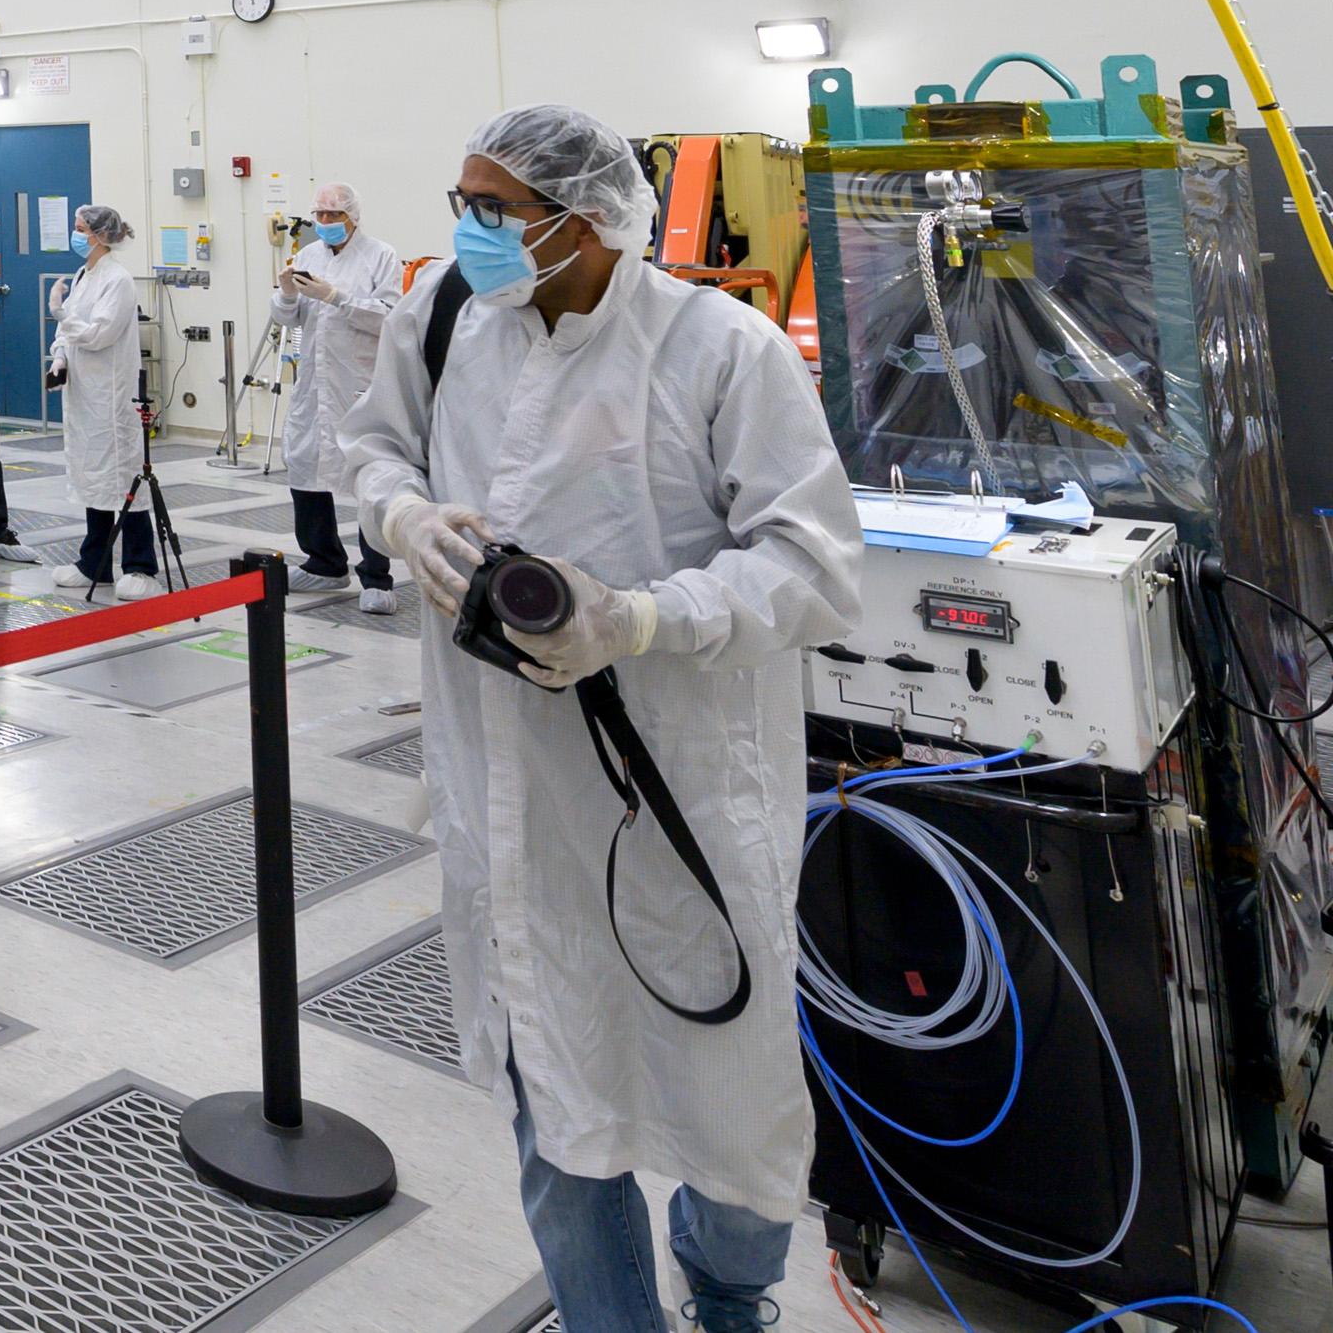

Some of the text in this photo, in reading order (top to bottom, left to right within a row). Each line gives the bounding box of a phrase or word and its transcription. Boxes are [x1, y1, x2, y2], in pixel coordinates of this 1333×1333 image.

[953, 577, 975, 585] DP-1
[927, 582, 1003, 598] REFERENCE ONLY
[894, 640, 916, 650] DV-3
[828, 670, 852, 680] OPEN
[1006, 676, 1037, 687] CLOSE
[899, 682, 923, 693] OPEN
[890, 691, 905, 699] P-4
[968, 695, 993, 705] OPEN
[950, 702, 967, 711] P-3
[1024, 715, 1041, 723] P-2
[1046, 709, 1073, 719] OPEN
[1089, 726, 1106, 734] P-1
